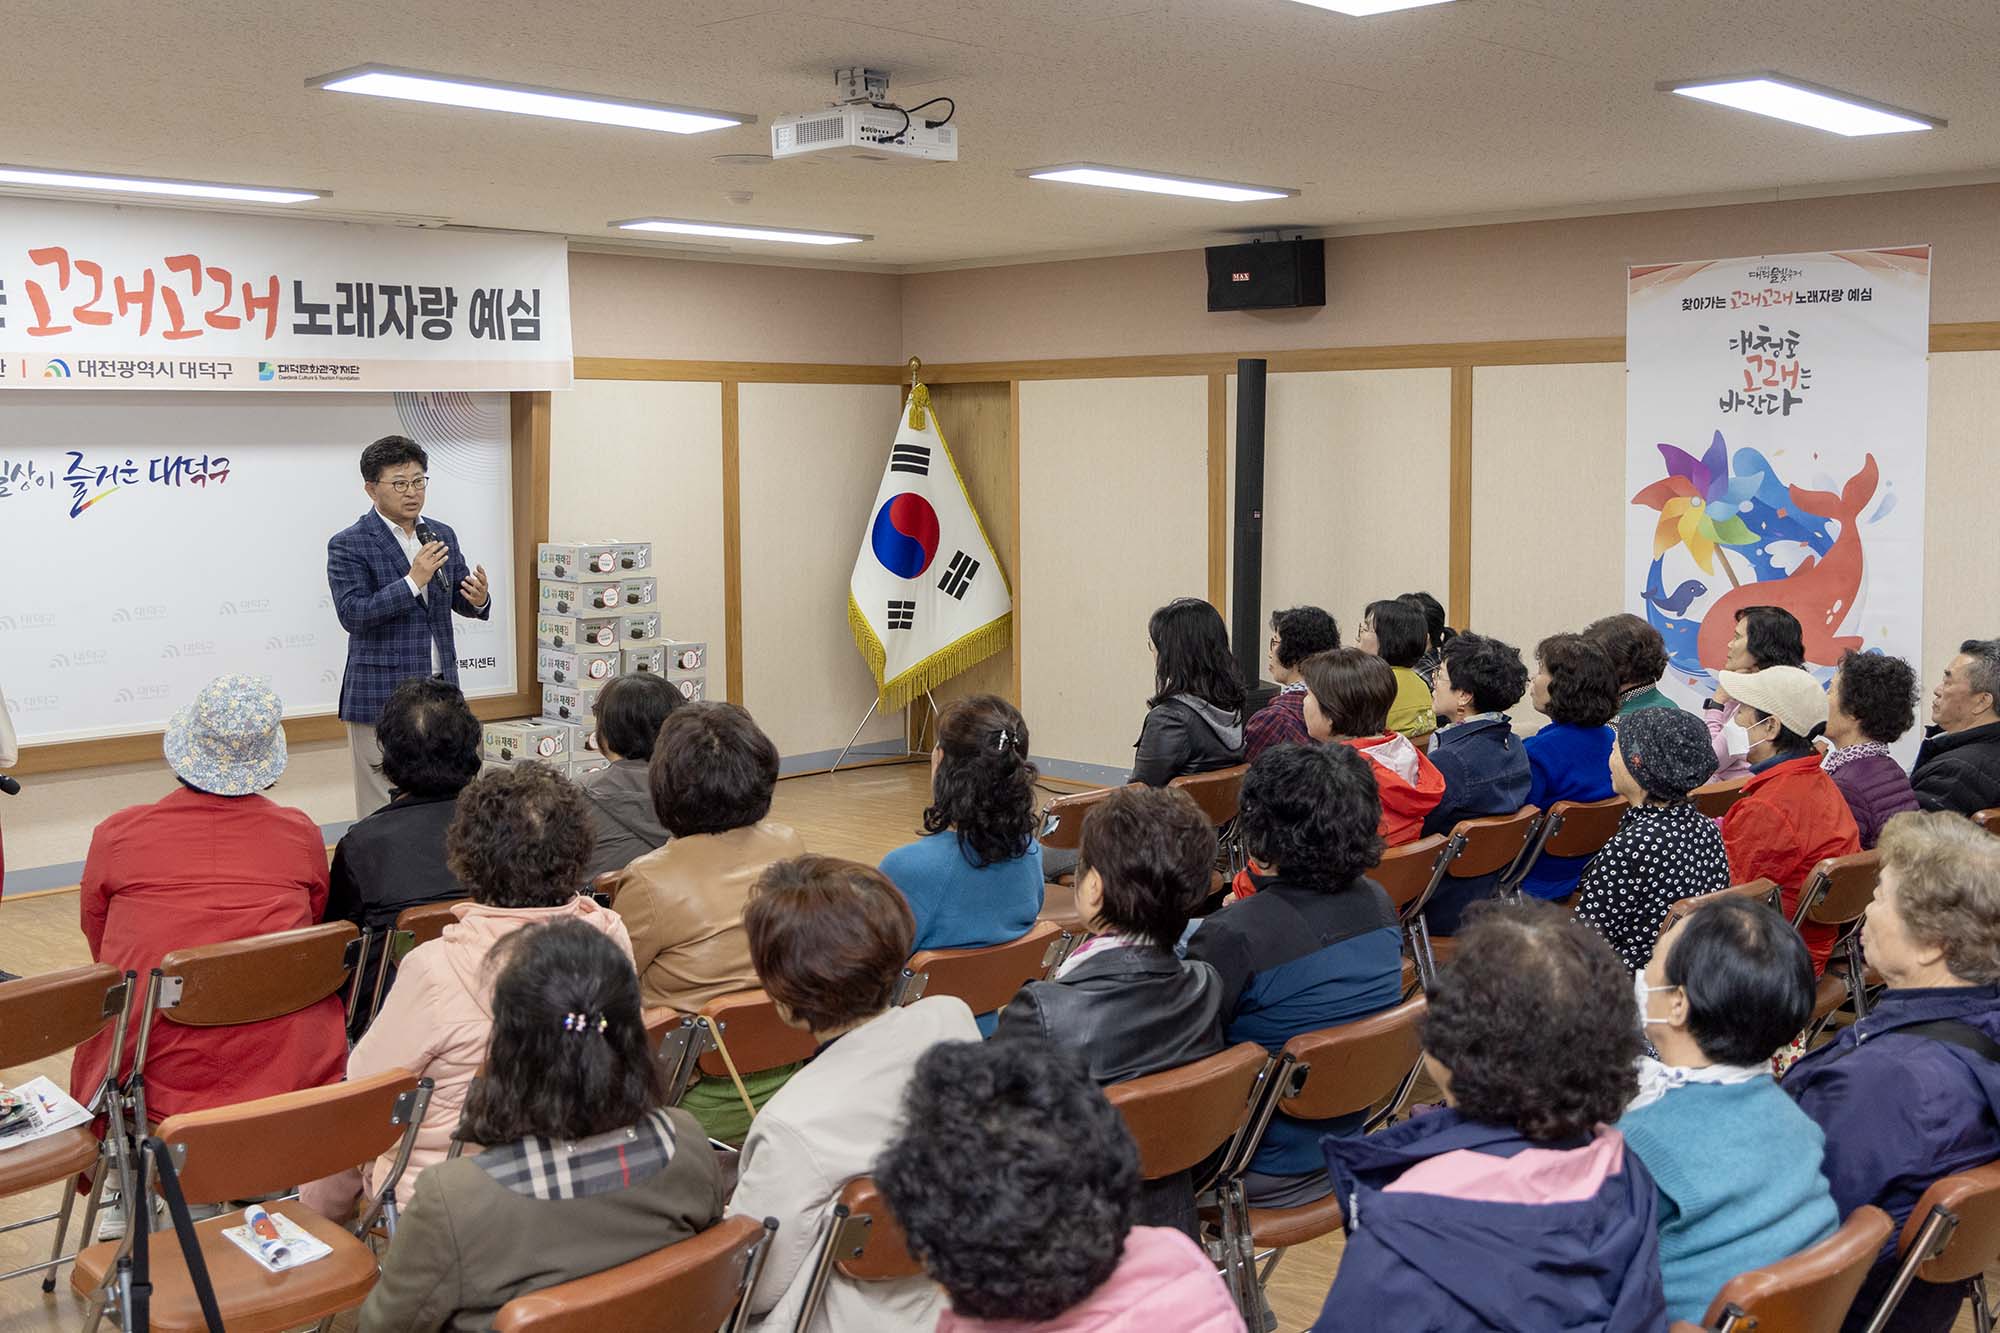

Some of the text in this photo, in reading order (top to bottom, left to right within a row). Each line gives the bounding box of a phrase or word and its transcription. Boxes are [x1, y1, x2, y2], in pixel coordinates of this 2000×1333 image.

[25, 246, 280, 340] 고래고래
[293, 280, 458, 341] 노래자랑
[469, 288, 541, 341] 예심
[1682, 288, 1872, 311] 찾아가는 고래고래 노래자랑 예심
[1729, 324, 1800, 359] 대청호
[78, 360, 233, 380] 대전광역시 대덕구
[277, 364, 360, 374] 대덕문화관광재단
[1719, 388, 1803, 416] 바란다
[63, 451, 139, 519] 즐거운
[149, 455, 230, 488] 대덕구
[456, 657, 495, 669] 복지센터
